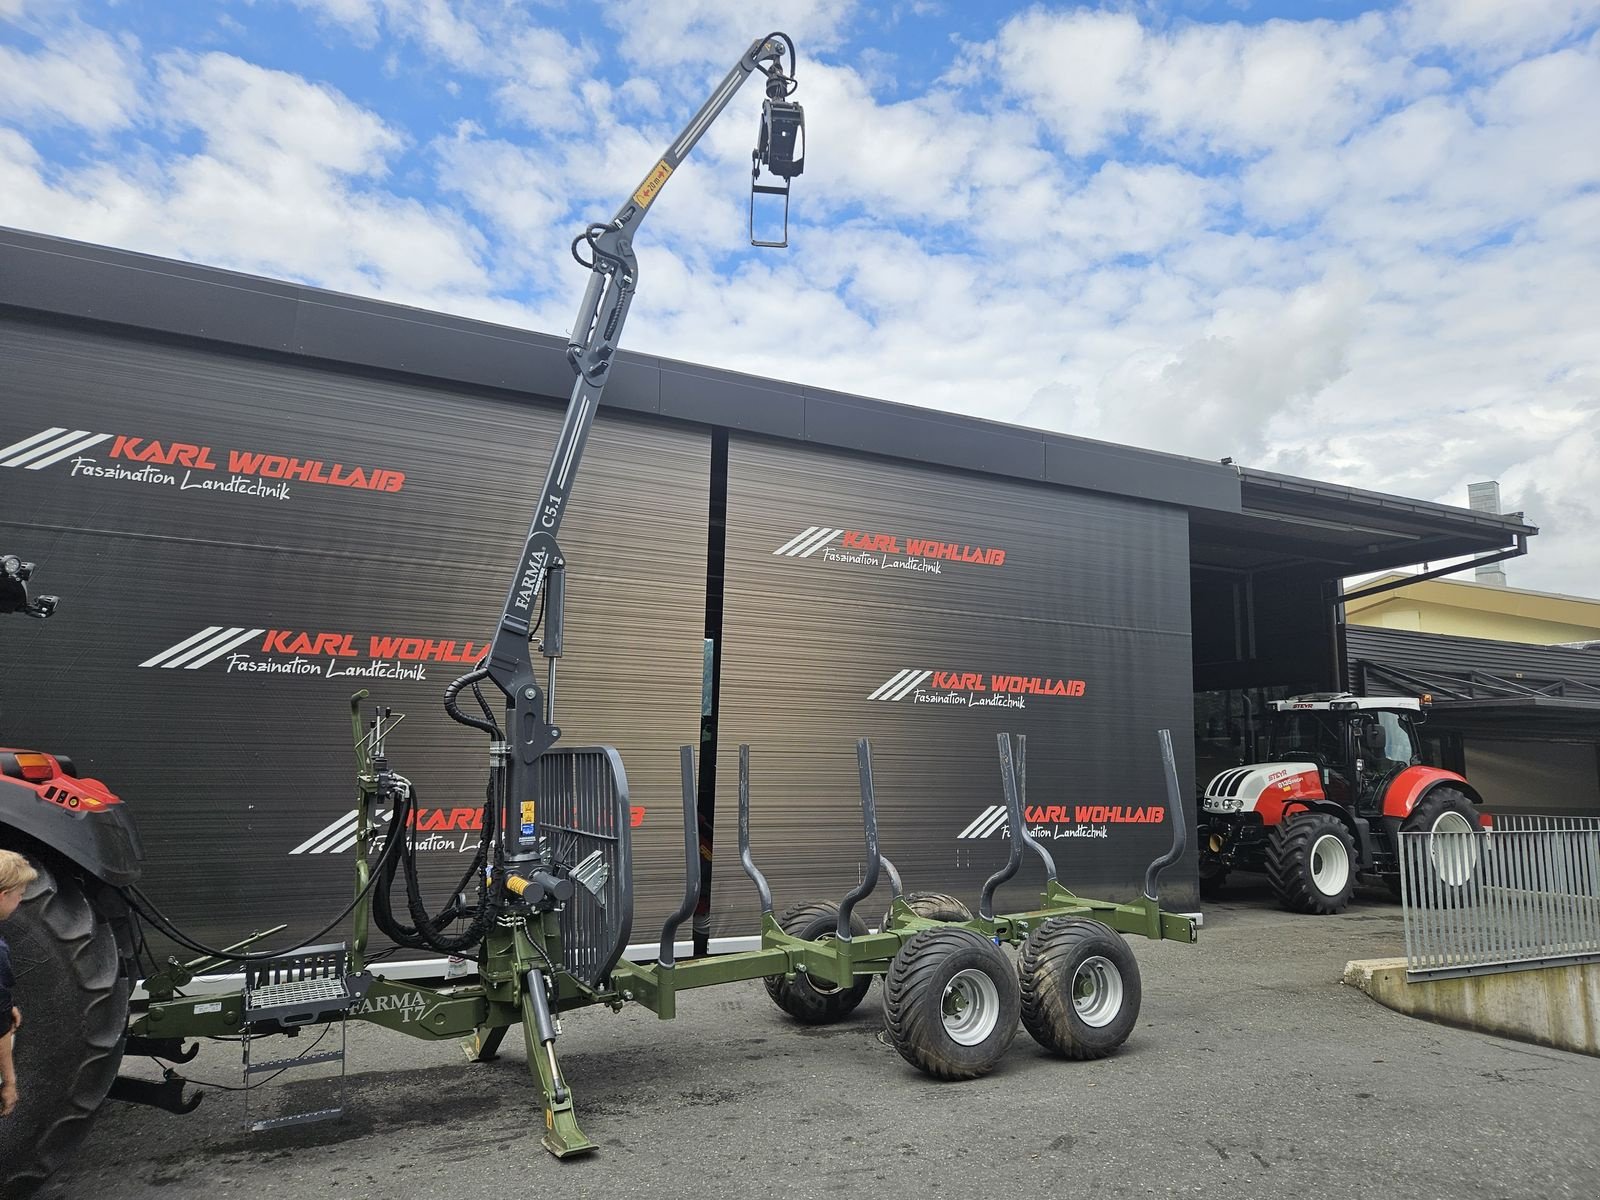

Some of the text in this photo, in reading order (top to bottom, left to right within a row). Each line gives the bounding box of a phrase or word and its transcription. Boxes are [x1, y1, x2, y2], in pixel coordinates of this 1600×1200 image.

[110, 435, 405, 493] KARL WOHLLAIB
[70, 456, 291, 500] Faszination Landtechnik
[541, 494, 562, 528] C5.1
[823, 548, 942, 575] Faszination Landtechnik
[843, 531, 1006, 566] KARL WOHLLAIB
[514, 550, 546, 611] FARMA
[262, 629, 492, 663] KARL WOHLL
[226, 653, 427, 681] Faszination Landtechnik
[931, 671, 1086, 697] KARL WOHLLAIB
[914, 688, 1026, 710] Faszination Landtechnik
[405, 807, 485, 831] KARL
[1024, 805, 1165, 824] KARL WOHLLAIB
[1053, 823, 1108, 840] Landtechnik
[349, 991, 426, 1016] FARMA
[399, 1005, 426, 1023] T7
